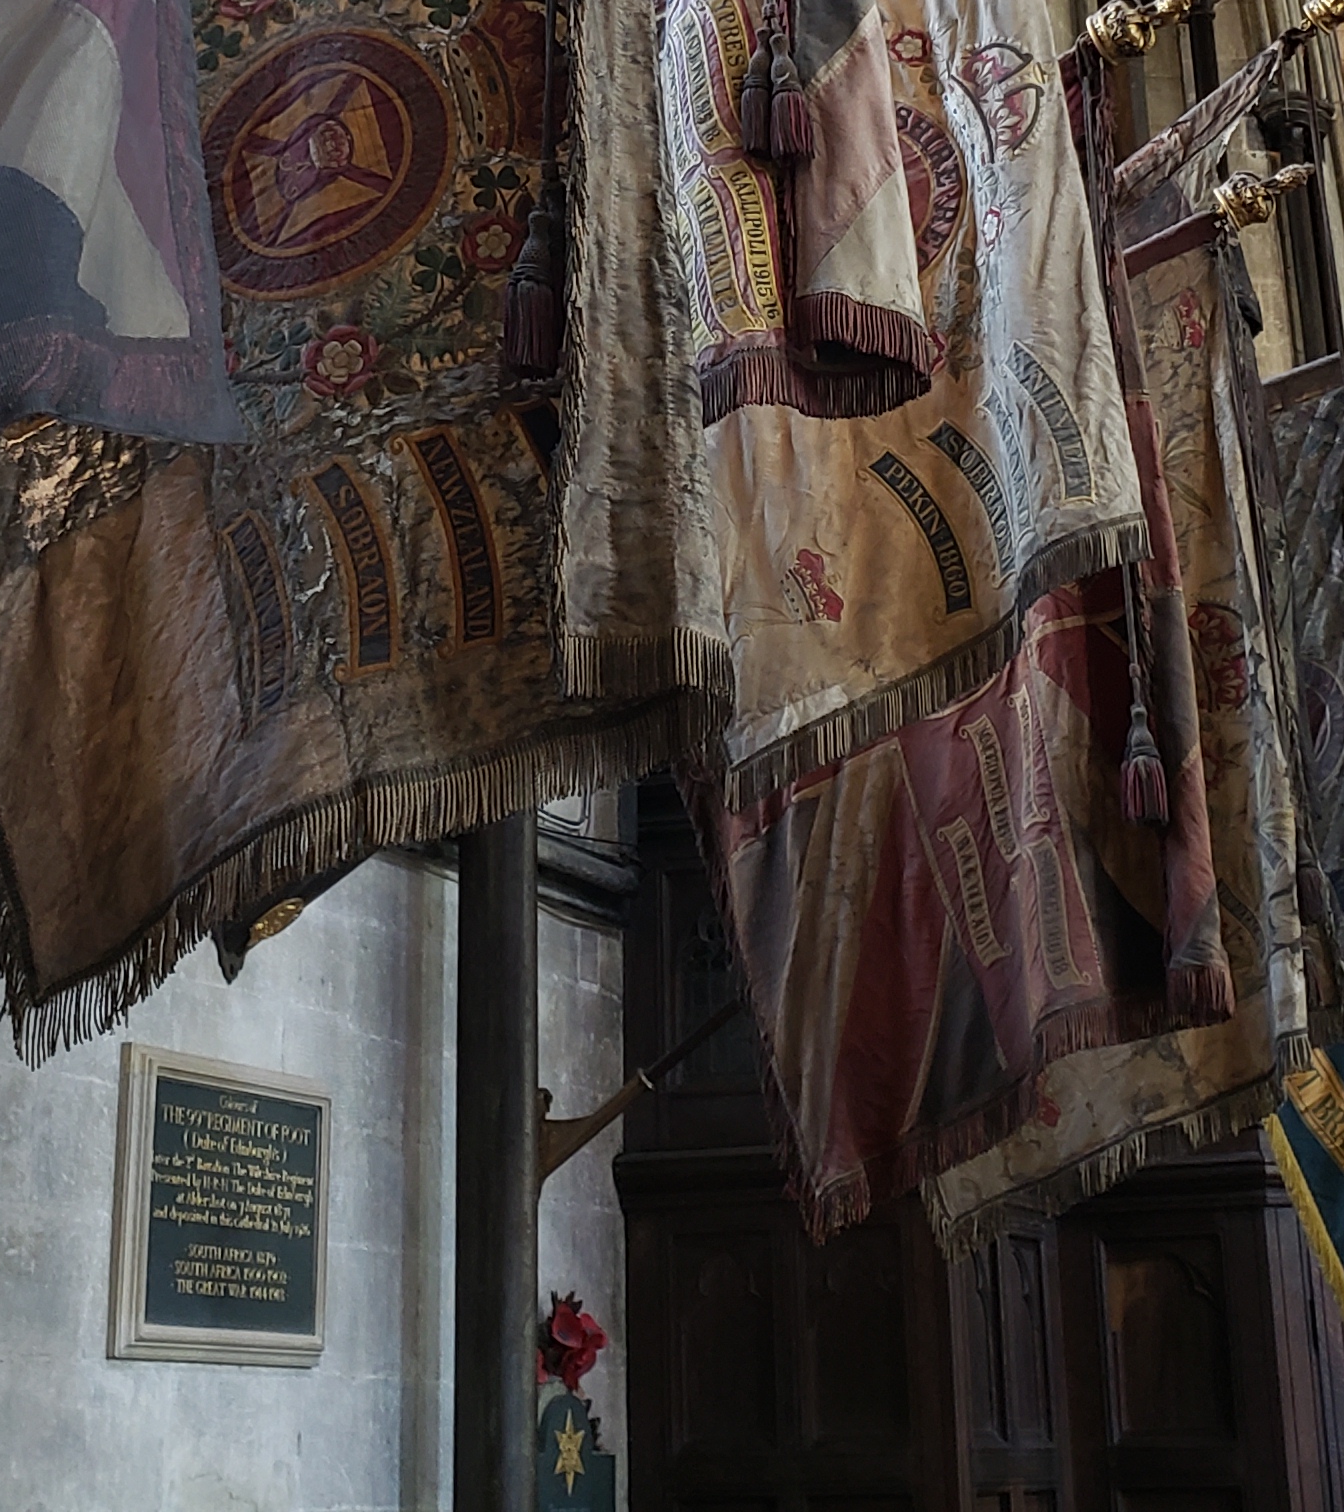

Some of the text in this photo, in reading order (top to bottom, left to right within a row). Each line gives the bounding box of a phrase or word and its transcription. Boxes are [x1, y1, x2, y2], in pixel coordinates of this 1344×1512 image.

[730, 171, 765, 256] GALLIPOLI
[338, 485, 388, 638] SOBRAON
[422, 438, 494, 638] NEW ZEALAND
[885, 462, 968, 599] PEKIN 1860
[946, 432, 1016, 572] SOBRAON
[161, 1103, 186, 1126] THE
[207, 1112, 264, 1138] REGIMENT
[264, 1122, 280, 1141] OF
[280, 1124, 312, 1147] FOOT
